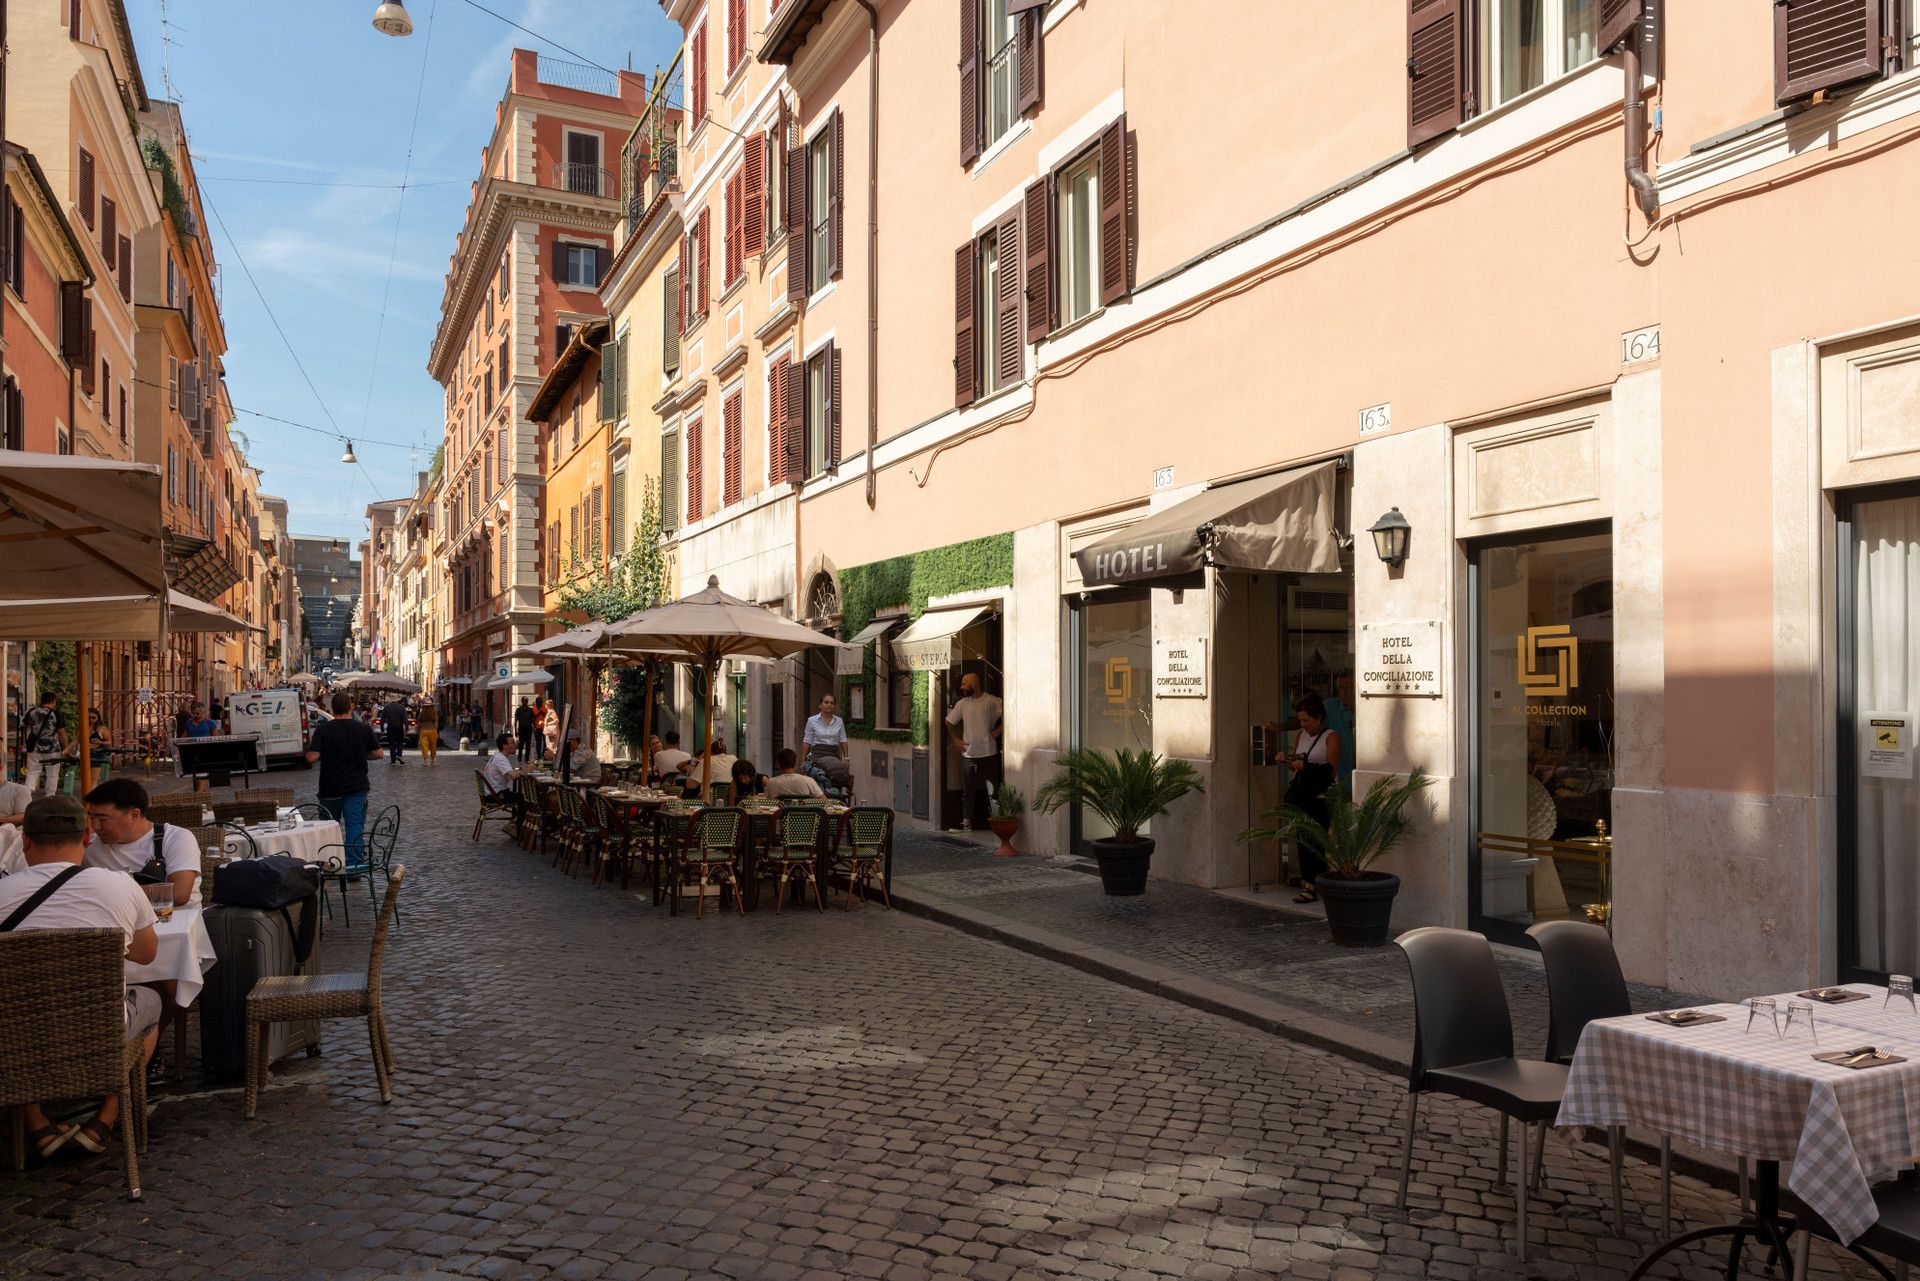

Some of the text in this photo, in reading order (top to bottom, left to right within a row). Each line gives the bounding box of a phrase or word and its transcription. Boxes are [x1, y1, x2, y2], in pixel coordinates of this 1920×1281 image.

[1622, 331, 1661, 362] 164
[1155, 469, 1172, 487] 163
[1096, 543, 1168, 580] HOTEL
[1382, 637, 1413, 648] HOTEL
[1168, 650, 1189, 659] HOTEL
[1382, 654, 1413, 665] DELLA
[1168, 663, 1189, 672] DELLA
[1156, 677, 1203, 686] CONCILIAZIONE
[1363, 671, 1434, 682] CONCILIAZIONE
[1524, 705, 1587, 716] COLLECTION
[1536, 717, 1561, 727] Hotels
